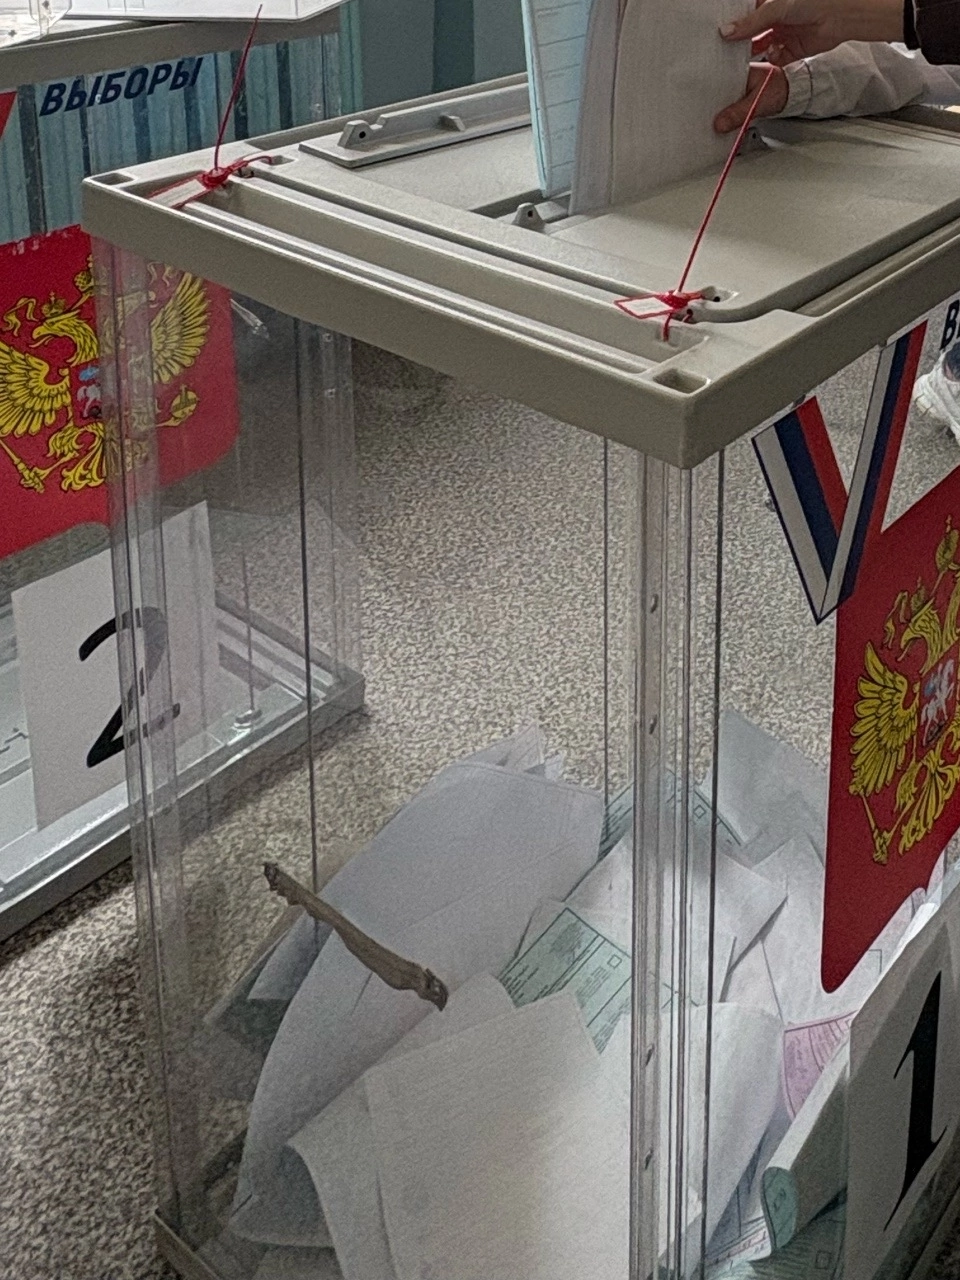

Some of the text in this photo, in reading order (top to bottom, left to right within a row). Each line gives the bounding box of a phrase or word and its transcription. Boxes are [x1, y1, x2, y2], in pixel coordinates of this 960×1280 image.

[39, 57, 204, 117] ВЫБОРЫ
[78, 606, 181, 768] 2
[884, 970, 949, 1233] 1
